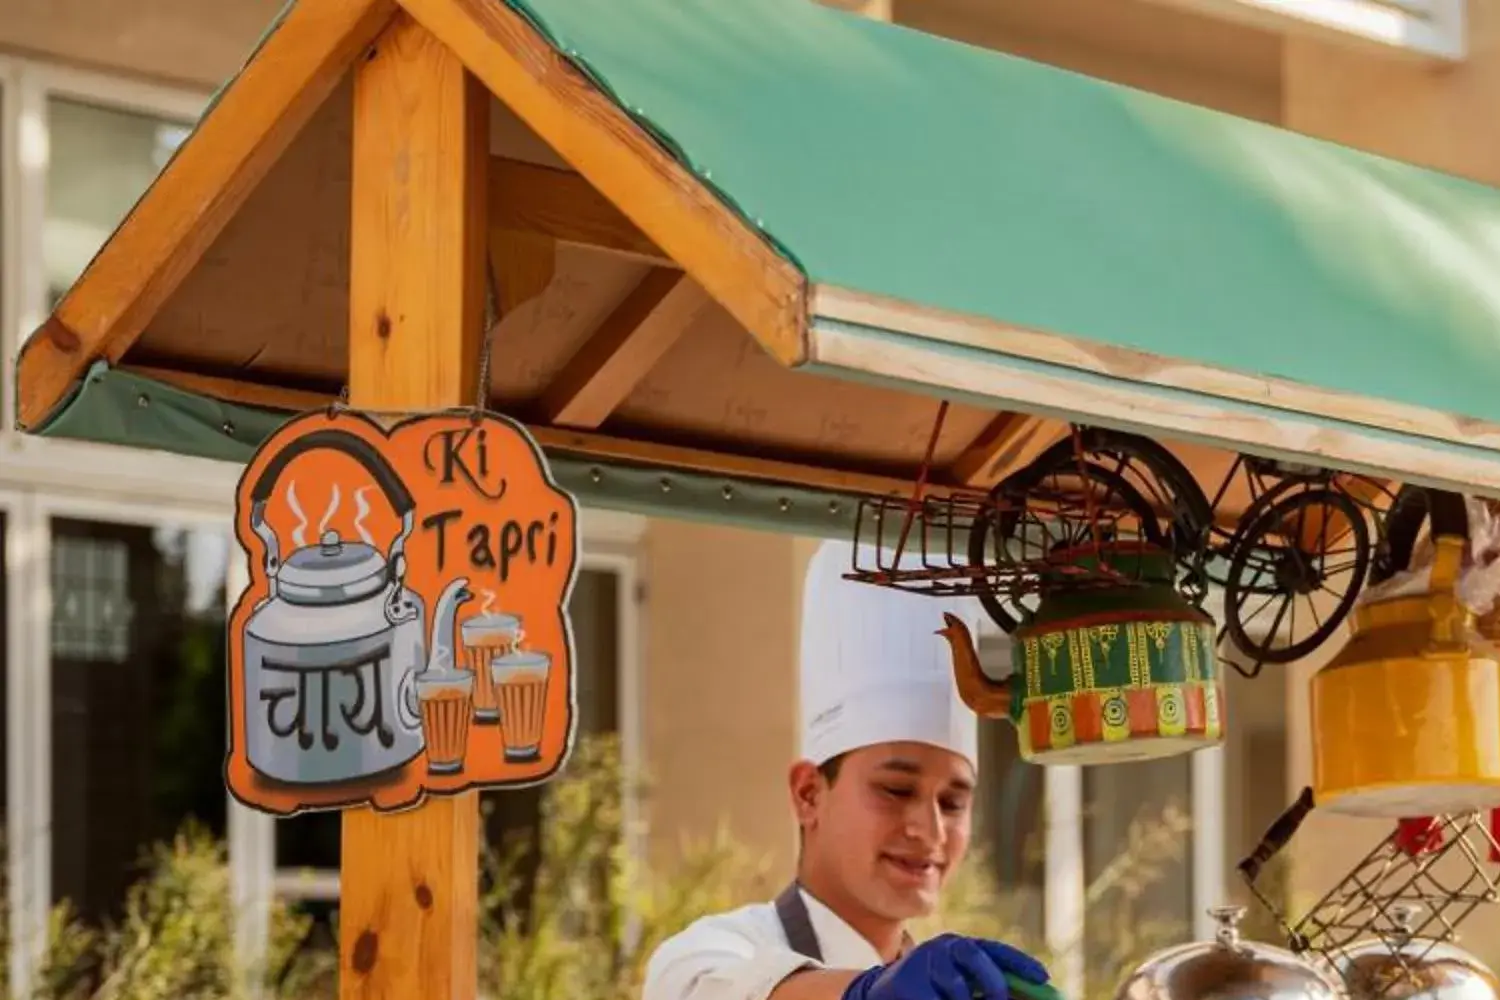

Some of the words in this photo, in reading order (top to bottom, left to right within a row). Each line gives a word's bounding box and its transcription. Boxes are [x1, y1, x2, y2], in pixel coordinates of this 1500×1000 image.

[424, 429, 506, 499] Ki
[422, 510, 559, 582] Tapri
[259, 644, 394, 750] चाय
